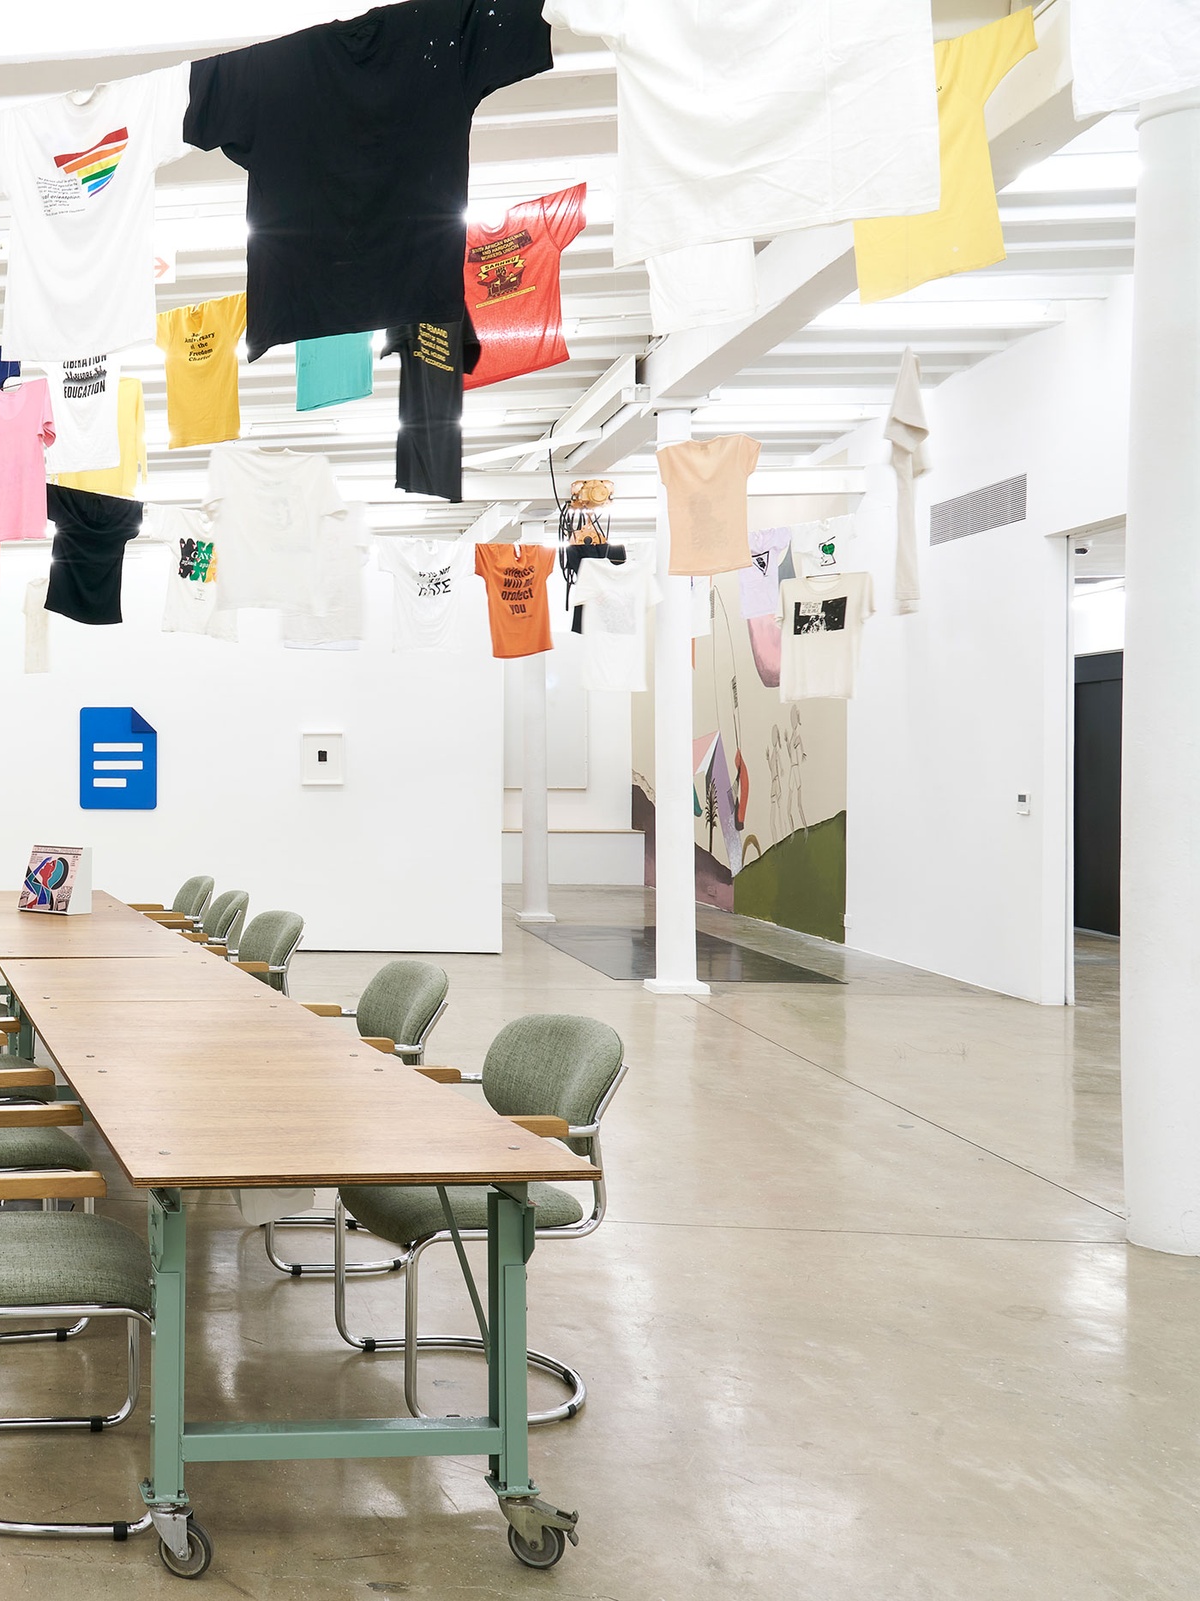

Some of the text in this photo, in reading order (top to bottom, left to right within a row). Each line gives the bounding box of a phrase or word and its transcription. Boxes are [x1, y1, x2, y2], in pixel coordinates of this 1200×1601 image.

[484, 240, 504, 250] AFRICAN
[503, 231, 526, 244] RAILWAY
[502, 244, 520, 254] UNION
[189, 348, 213, 356] Freedom
[64, 379, 106, 399] EDUCATION
[503, 578, 522, 589] will
[501, 588, 534, 601] protect
[509, 604, 527, 615] you
